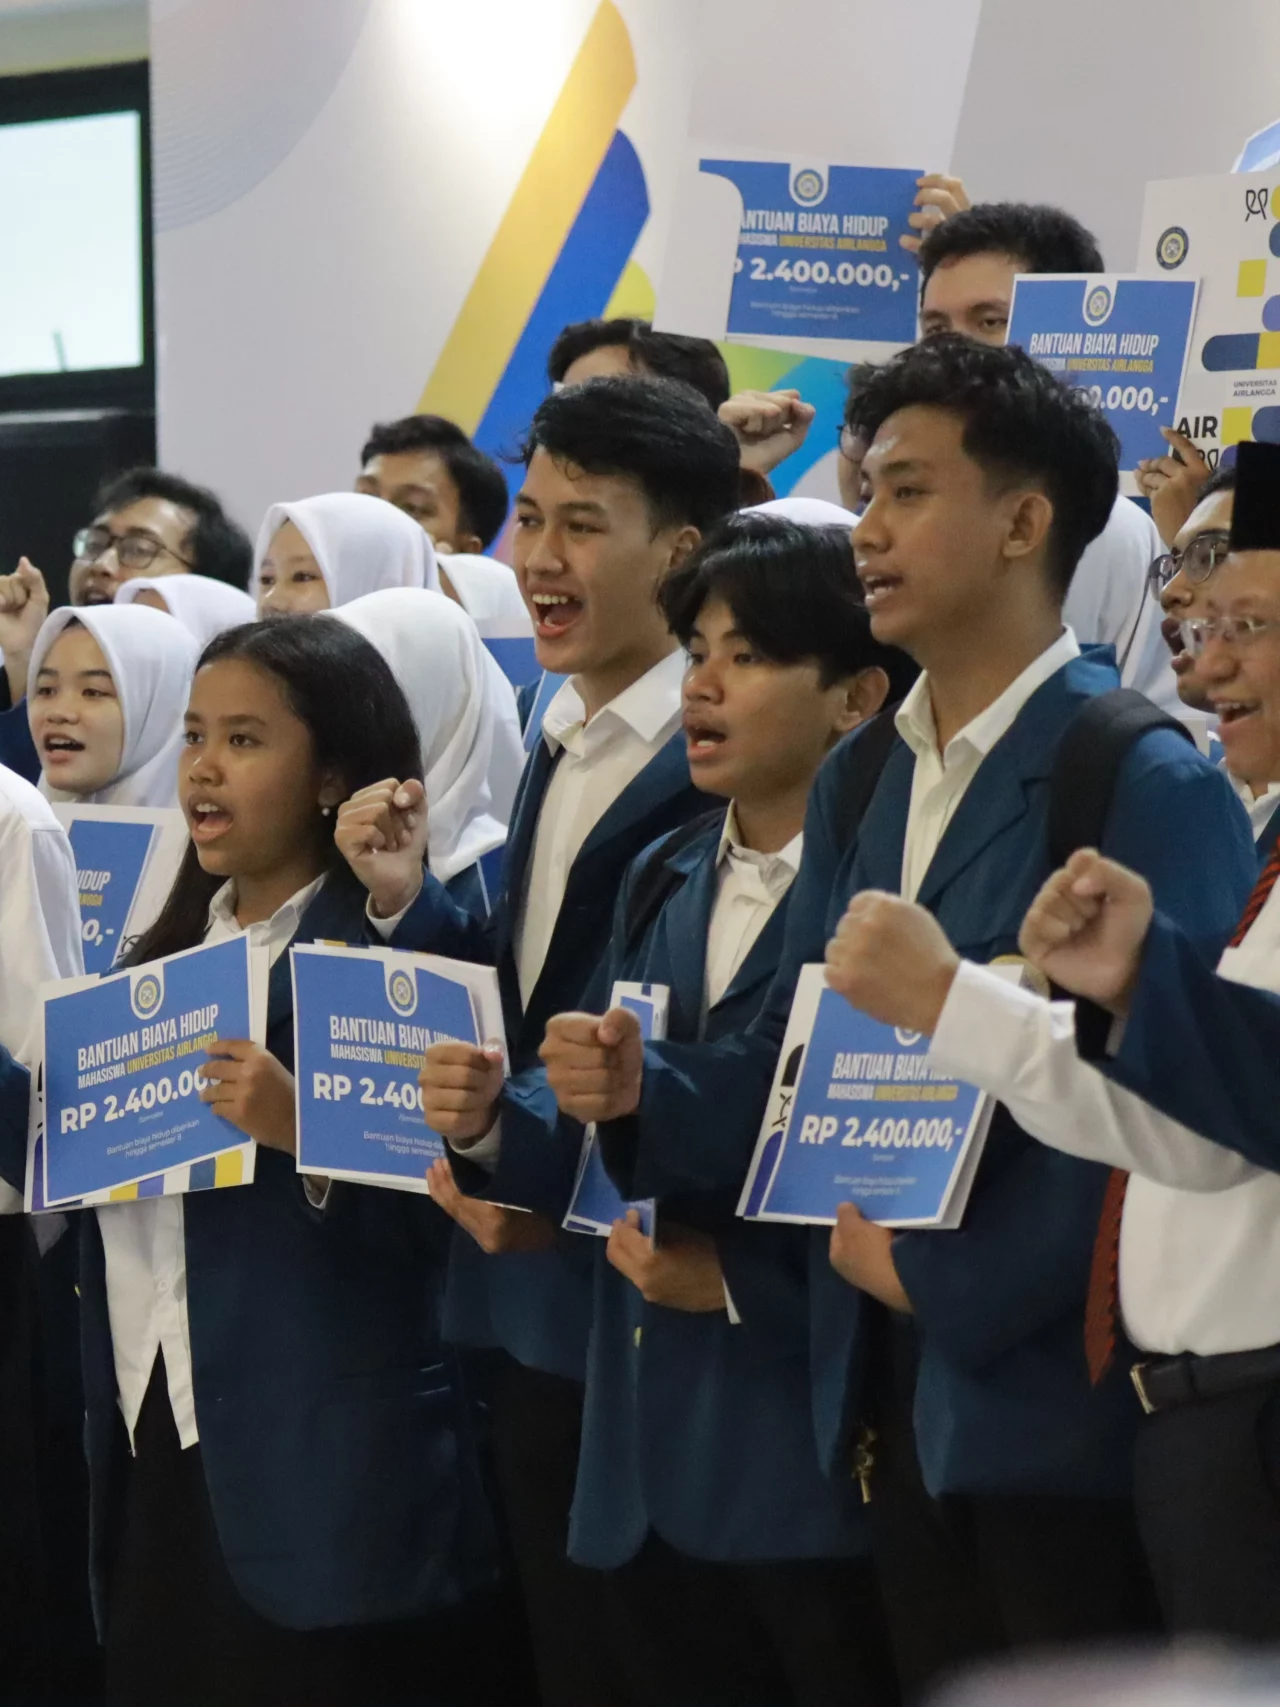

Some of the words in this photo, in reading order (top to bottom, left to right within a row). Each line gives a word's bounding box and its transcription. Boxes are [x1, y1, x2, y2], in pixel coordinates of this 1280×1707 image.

[797, 212, 839, 234] BIAYA
[842, 215, 889, 237] HIDUP
[750, 257, 910, 292] 2.400.000,-
[1029, 333, 1083, 354] BANTUAN
[1083, 333, 1118, 355] BIAYA
[1119, 334, 1159, 356] HIDUP
[1233, 379, 1278, 388] UNIVERSITAS
[1233, 389, 1276, 397] AIRLANGGA
[1177, 415, 1218, 438] AIR
[77, 869, 111, 891] IDUP
[78, 1031, 139, 1072] BANTUAN
[141, 1018, 177, 1052] BIAYA
[180, 1003, 219, 1038] HIDUP
[329, 1015, 395, 1046] BANTUAN
[330, 1043, 383, 1064] MAHASISWA
[832, 1052, 894, 1079] BANTUAN
[78, 1062, 126, 1090] MAHASISWA
[127, 1046, 175, 1074] UNIVERSITAS
[313, 1073, 352, 1101] RP
[60, 1101, 97, 1134] RP
[799, 1114, 838, 1144] RP
[841, 1115, 965, 1152] 2.400.000,-
[106, 1141, 134, 1155] Bantuan
